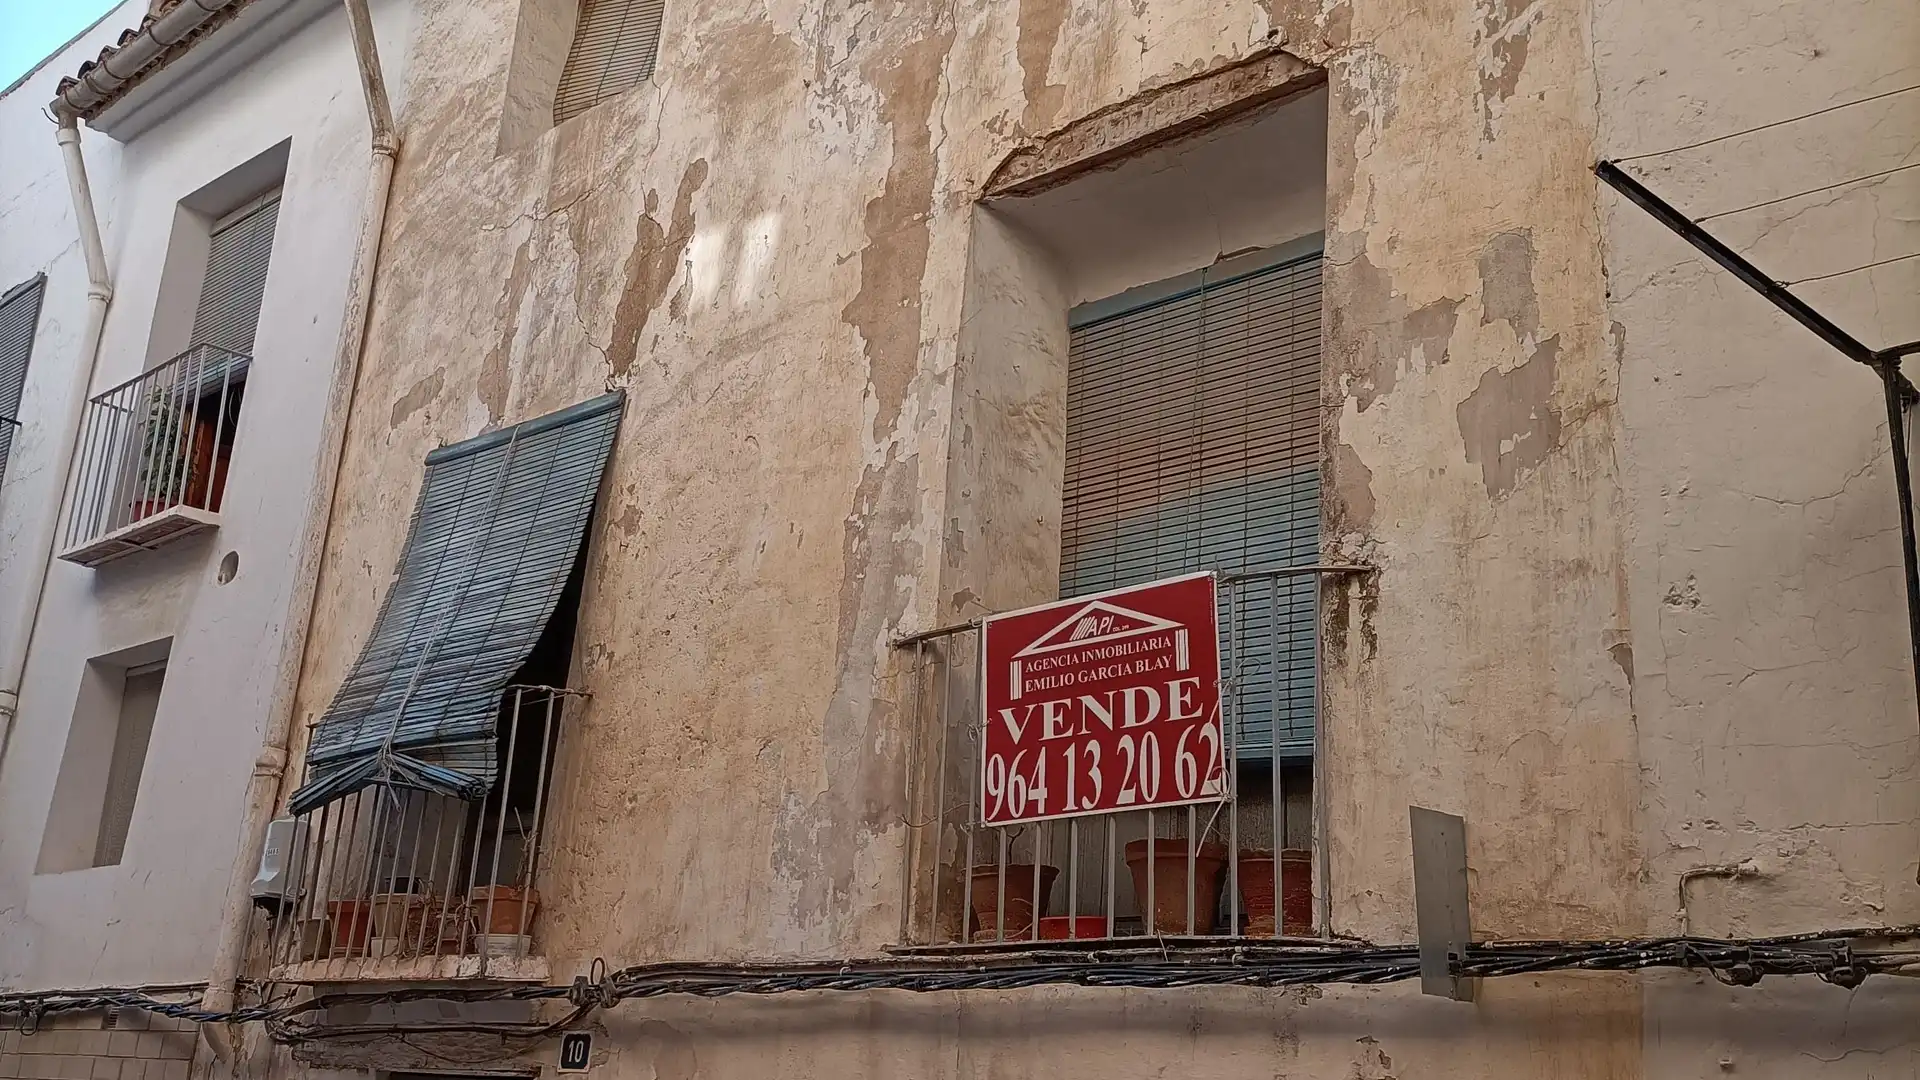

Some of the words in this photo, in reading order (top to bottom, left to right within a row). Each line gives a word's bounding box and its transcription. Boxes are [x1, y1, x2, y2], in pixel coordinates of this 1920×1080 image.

[1085, 615, 1114, 637] API
[1025, 653, 1079, 673] AGENCIA
[1082, 636, 1171, 663] INMOBILIARIA
[1025, 672, 1075, 693] EMILIO
[1078, 663, 1133, 683] GARCIA
[1136, 655, 1173, 674] BLAY
[998, 676, 1204, 745] VENDE
[986, 746, 1048, 822] 964
[1062, 739, 1103, 811] 13
[1116, 730, 1161, 805] 20
[1174, 722, 1221, 799] 62
[568, 1040, 584, 1063] 10
